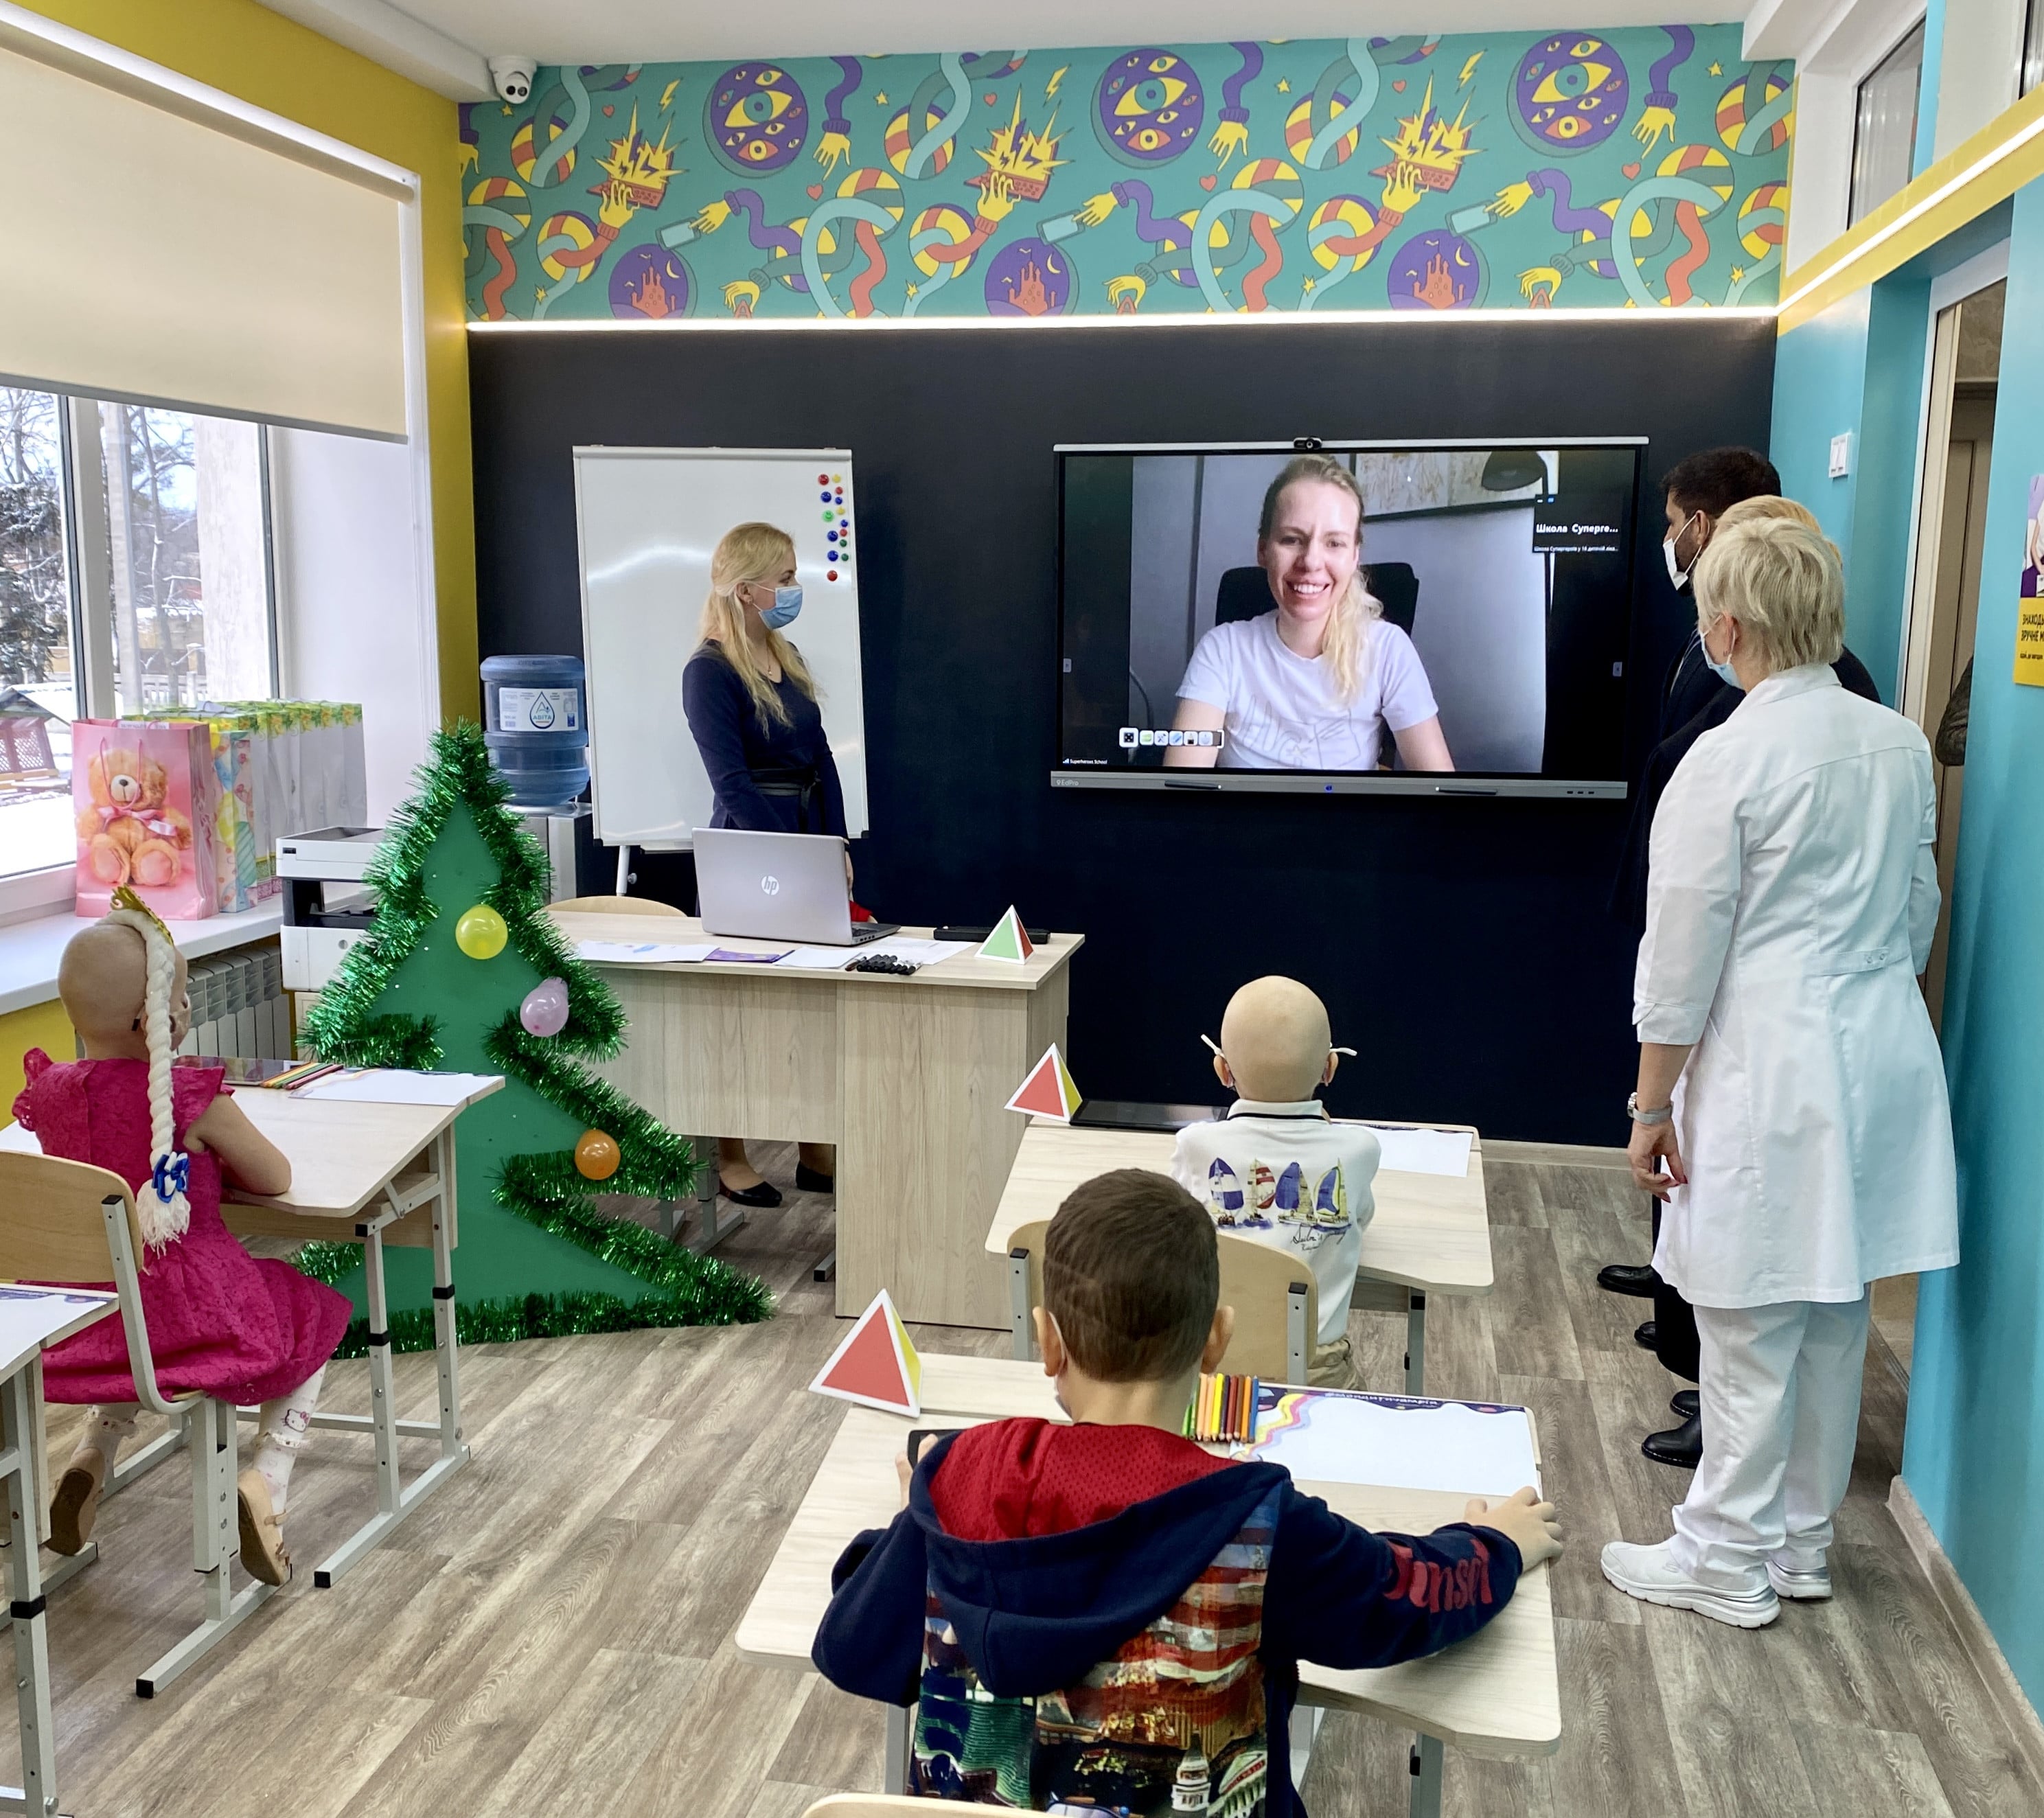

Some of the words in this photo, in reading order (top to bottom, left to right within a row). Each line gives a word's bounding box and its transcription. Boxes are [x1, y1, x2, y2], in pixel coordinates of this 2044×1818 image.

[1536, 523, 1568, 533] Школа
[1572, 523, 1618, 535] Суперге...
[763, 875, 777, 895] hp
